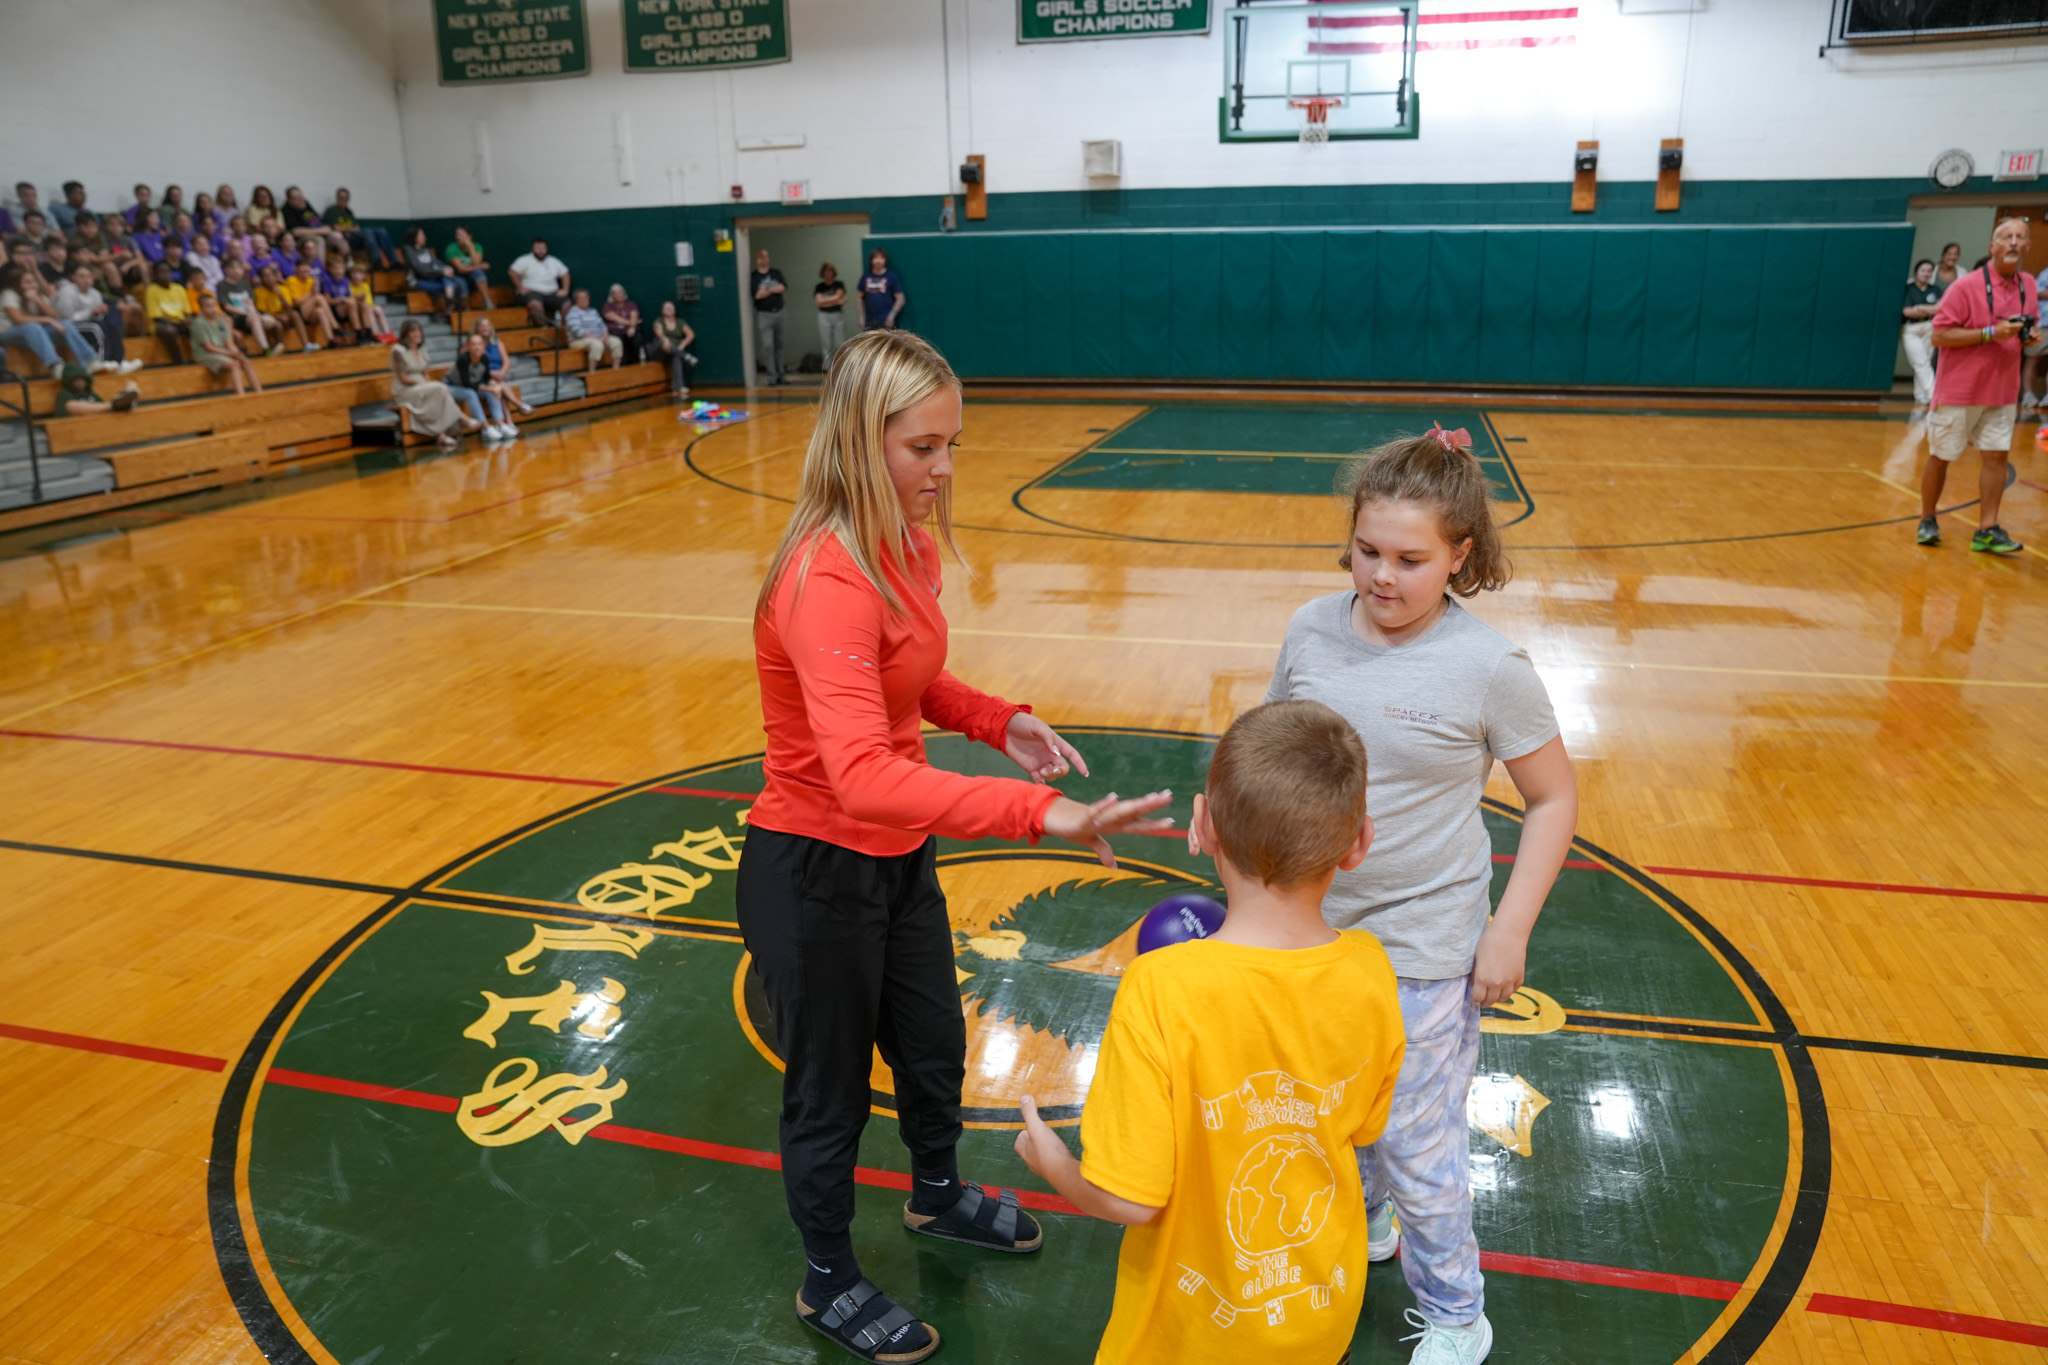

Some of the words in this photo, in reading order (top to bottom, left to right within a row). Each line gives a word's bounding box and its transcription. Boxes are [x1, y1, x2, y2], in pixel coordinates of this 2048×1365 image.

[448, 14, 478, 29] NEW
[481, 11, 519, 27] YORK
[523, 5, 571, 25] STATE
[638, 0, 670, 14] NEW
[1036, 0, 1098, 17] GIRLS
[664, 12, 726, 31] CLASS
[1054, 13, 1174, 34] CHAMPIONS
[473, 26, 532, 45] CLASS
[640, 32, 693, 50] GIRLS
[697, 24, 772, 46] SOCCER
[452, 45, 501, 63] GIRLS
[505, 39, 575, 59] SOCCER
[655, 44, 757, 65] CHAMPIONS
[465, 58, 561, 78] CHAMPIONS
[2008, 154, 2035, 172] EXIT
[1384, 706, 1443, 720] SPACEX
[1410, 716, 1438, 726] NETWORK
[456, 808, 751, 1147] AGLES
[1246, 1096, 1316, 1117] GAMES
[1242, 1110, 1318, 1134] AROUND
[1256, 1252, 1289, 1276] THE
[1242, 1265, 1302, 1300] GLOBE
